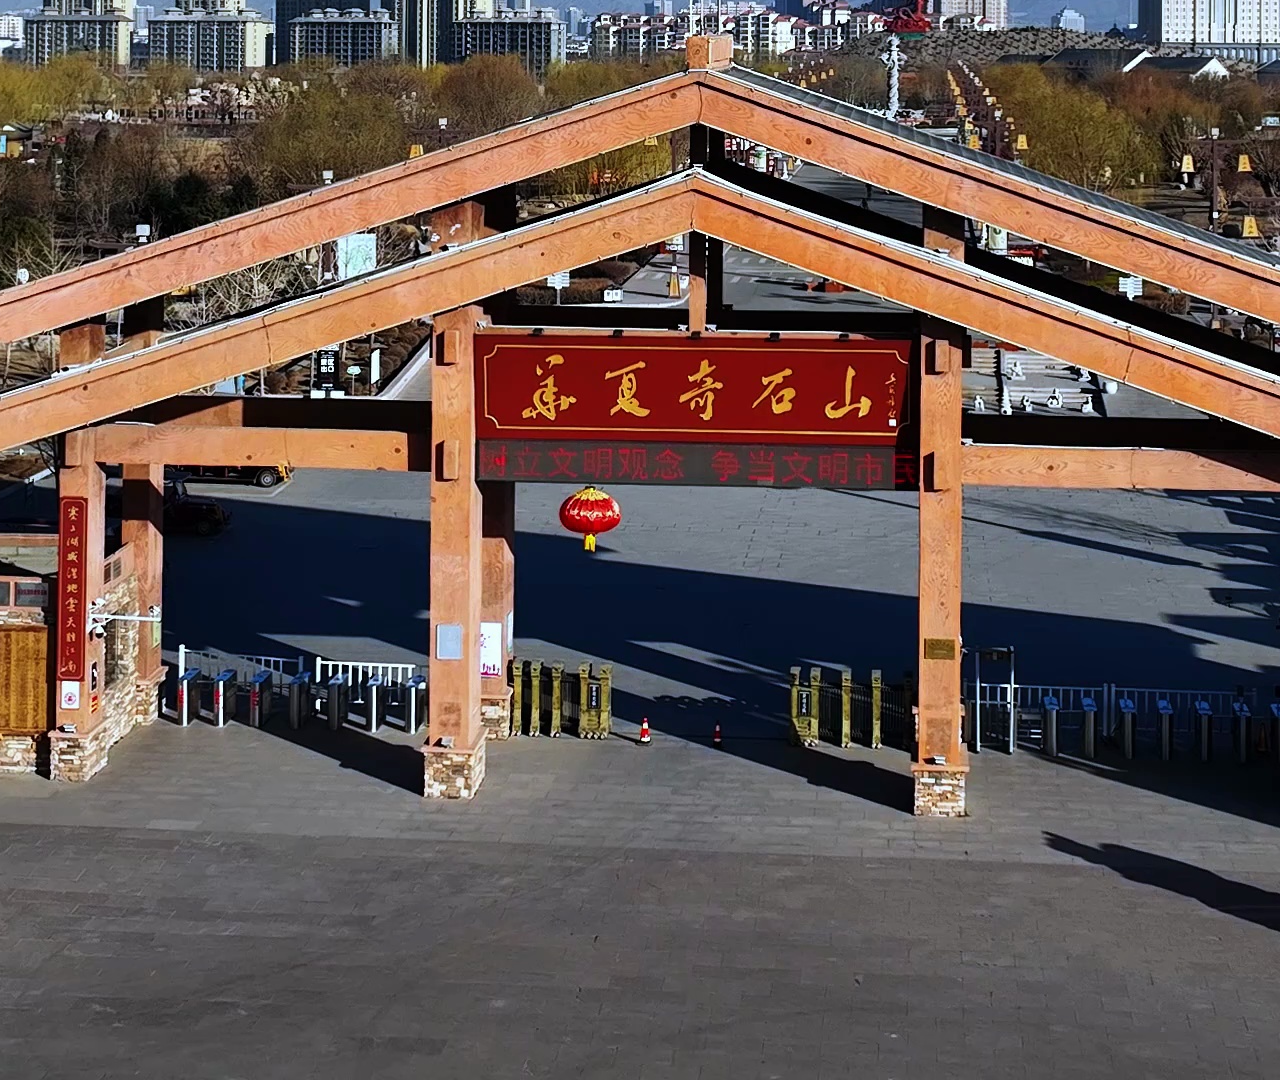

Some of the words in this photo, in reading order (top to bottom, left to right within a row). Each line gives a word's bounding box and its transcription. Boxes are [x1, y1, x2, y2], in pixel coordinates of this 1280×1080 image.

[480, 446, 685, 482] 树立文明观念
[711, 451, 917, 486] 争当文明市民
